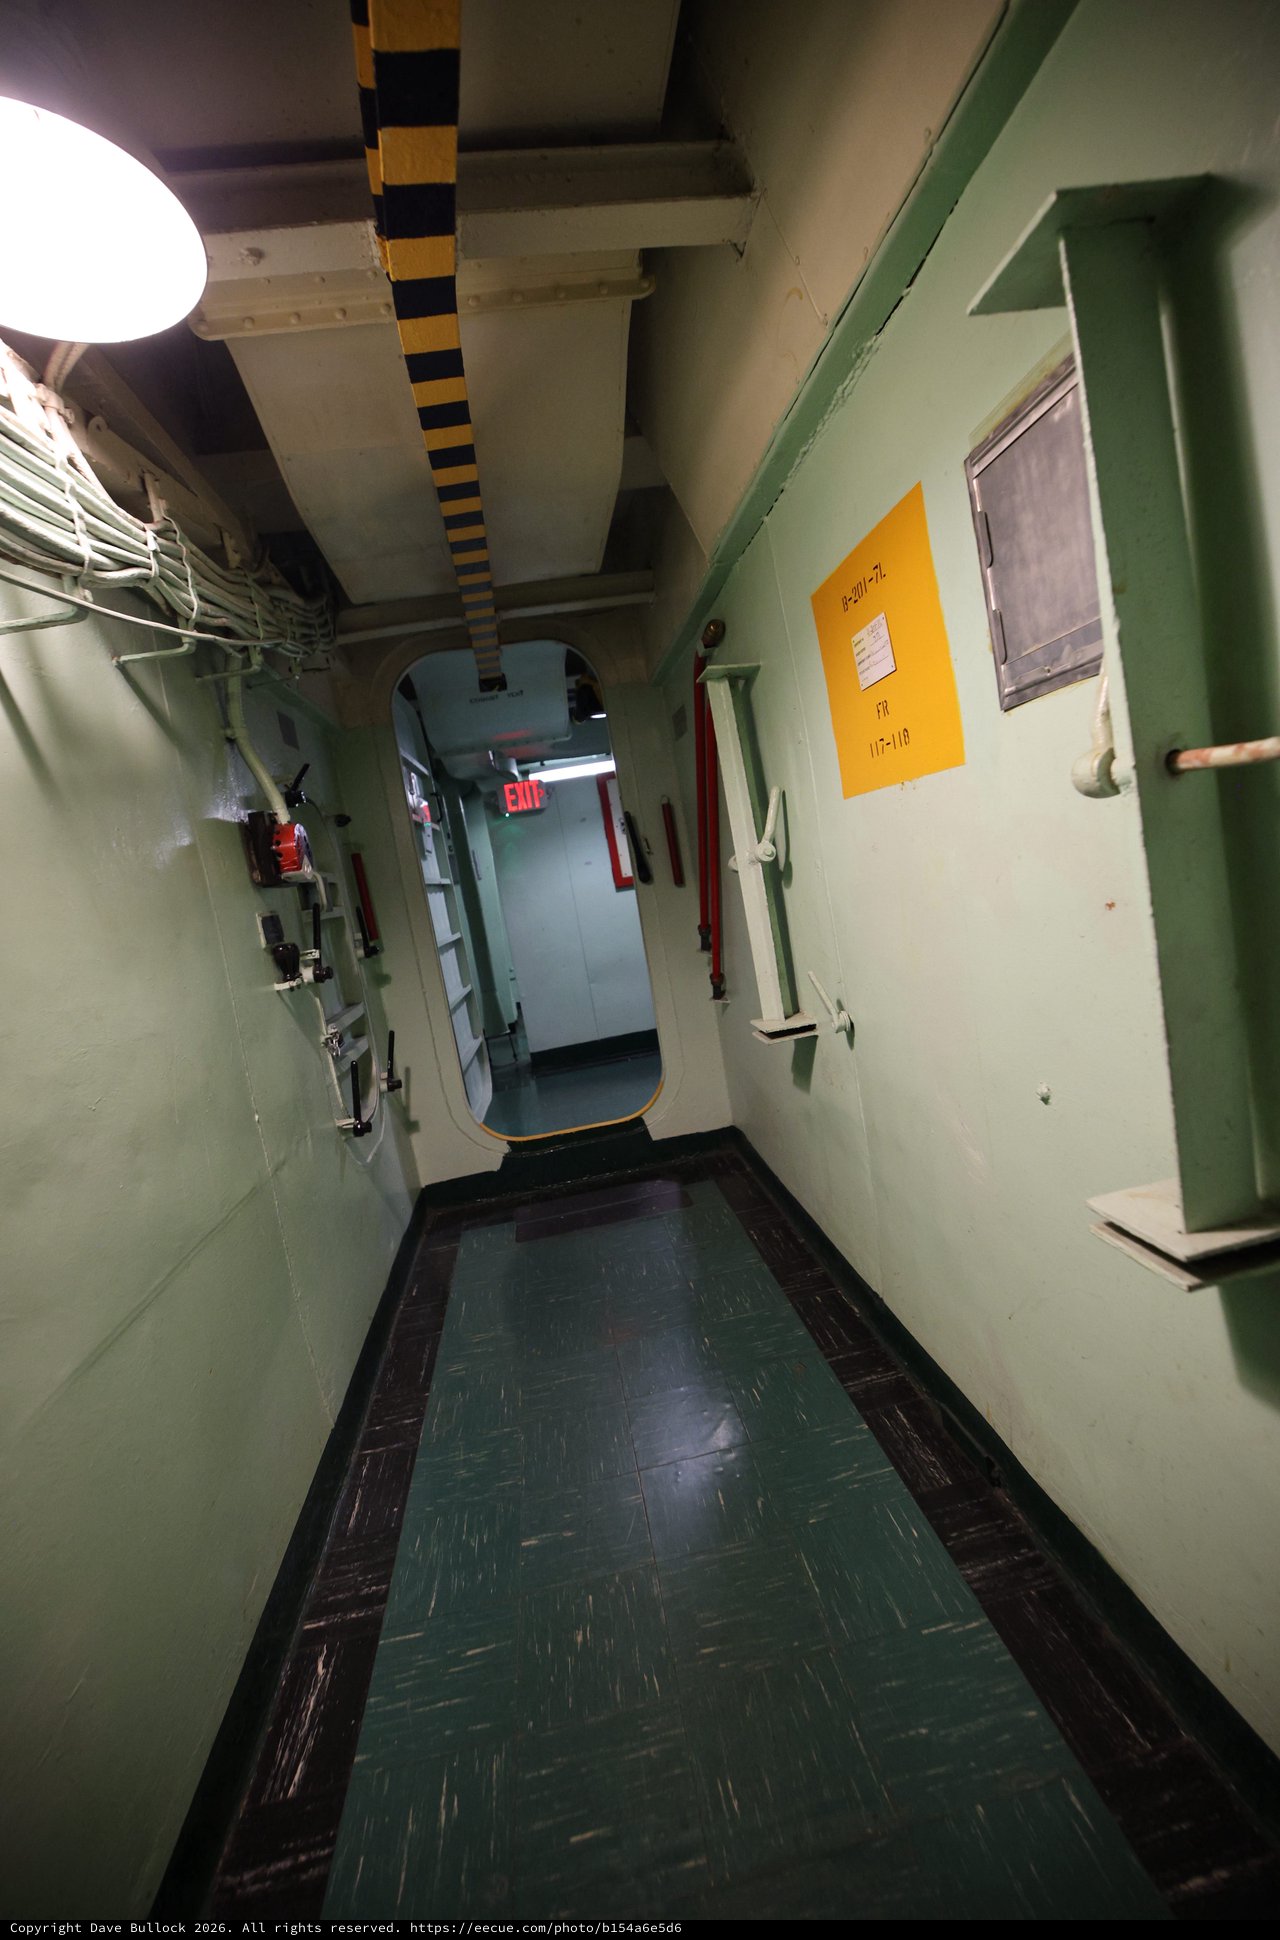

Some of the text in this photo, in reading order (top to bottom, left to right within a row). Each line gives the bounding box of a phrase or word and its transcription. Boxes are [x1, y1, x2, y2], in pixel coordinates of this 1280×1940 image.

[842, 562, 886, 612] B-201-7L
[876, 700, 890, 719] FR
[504, 780, 540, 812] EXIT
